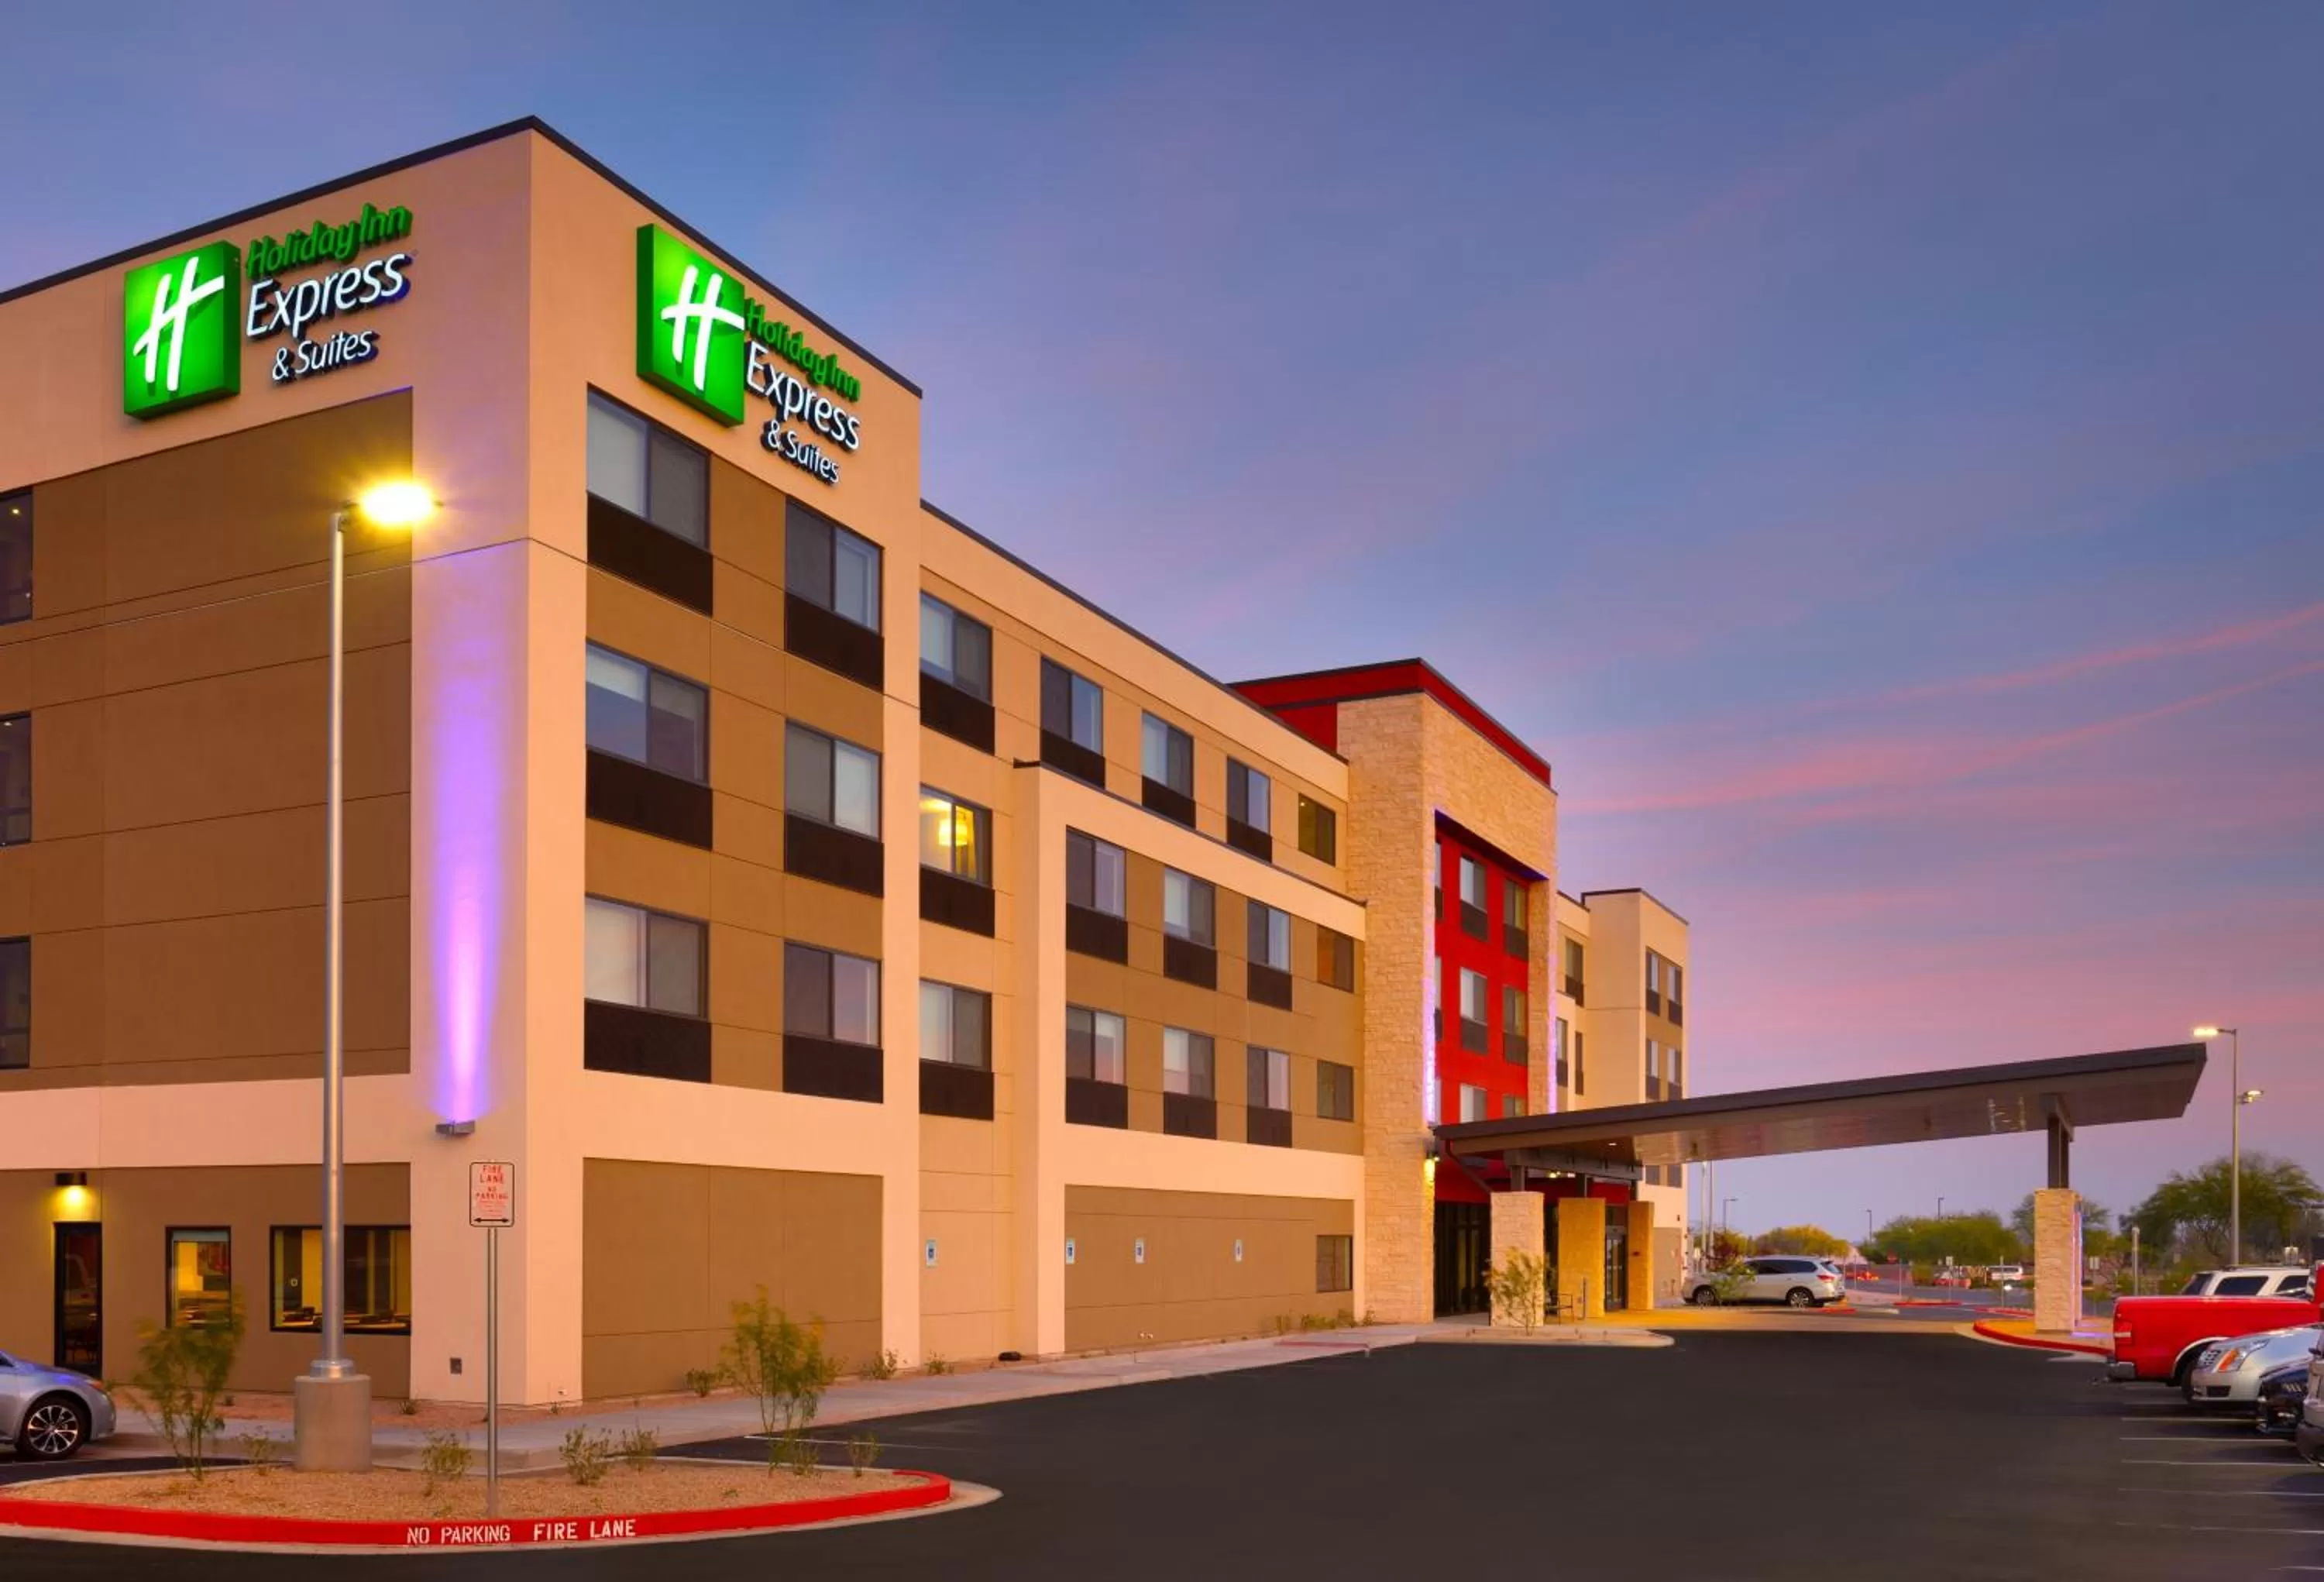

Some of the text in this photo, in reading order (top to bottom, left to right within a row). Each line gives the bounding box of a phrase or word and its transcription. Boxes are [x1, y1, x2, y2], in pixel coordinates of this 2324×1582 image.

[246, 202, 413, 278] Holiday Inn
[246, 253, 409, 339] Express
[272, 330, 376, 381] & Suites
[745, 297, 861, 401] Holiday Inn
[746, 341, 861, 451] Express
[765, 419, 839, 483] & Suites
[480, 1174, 504, 1184] LANE
[483, 1164, 501, 1173] FIRE
[407, 1518, 636, 1544] NO PARKING FIRE LANE
